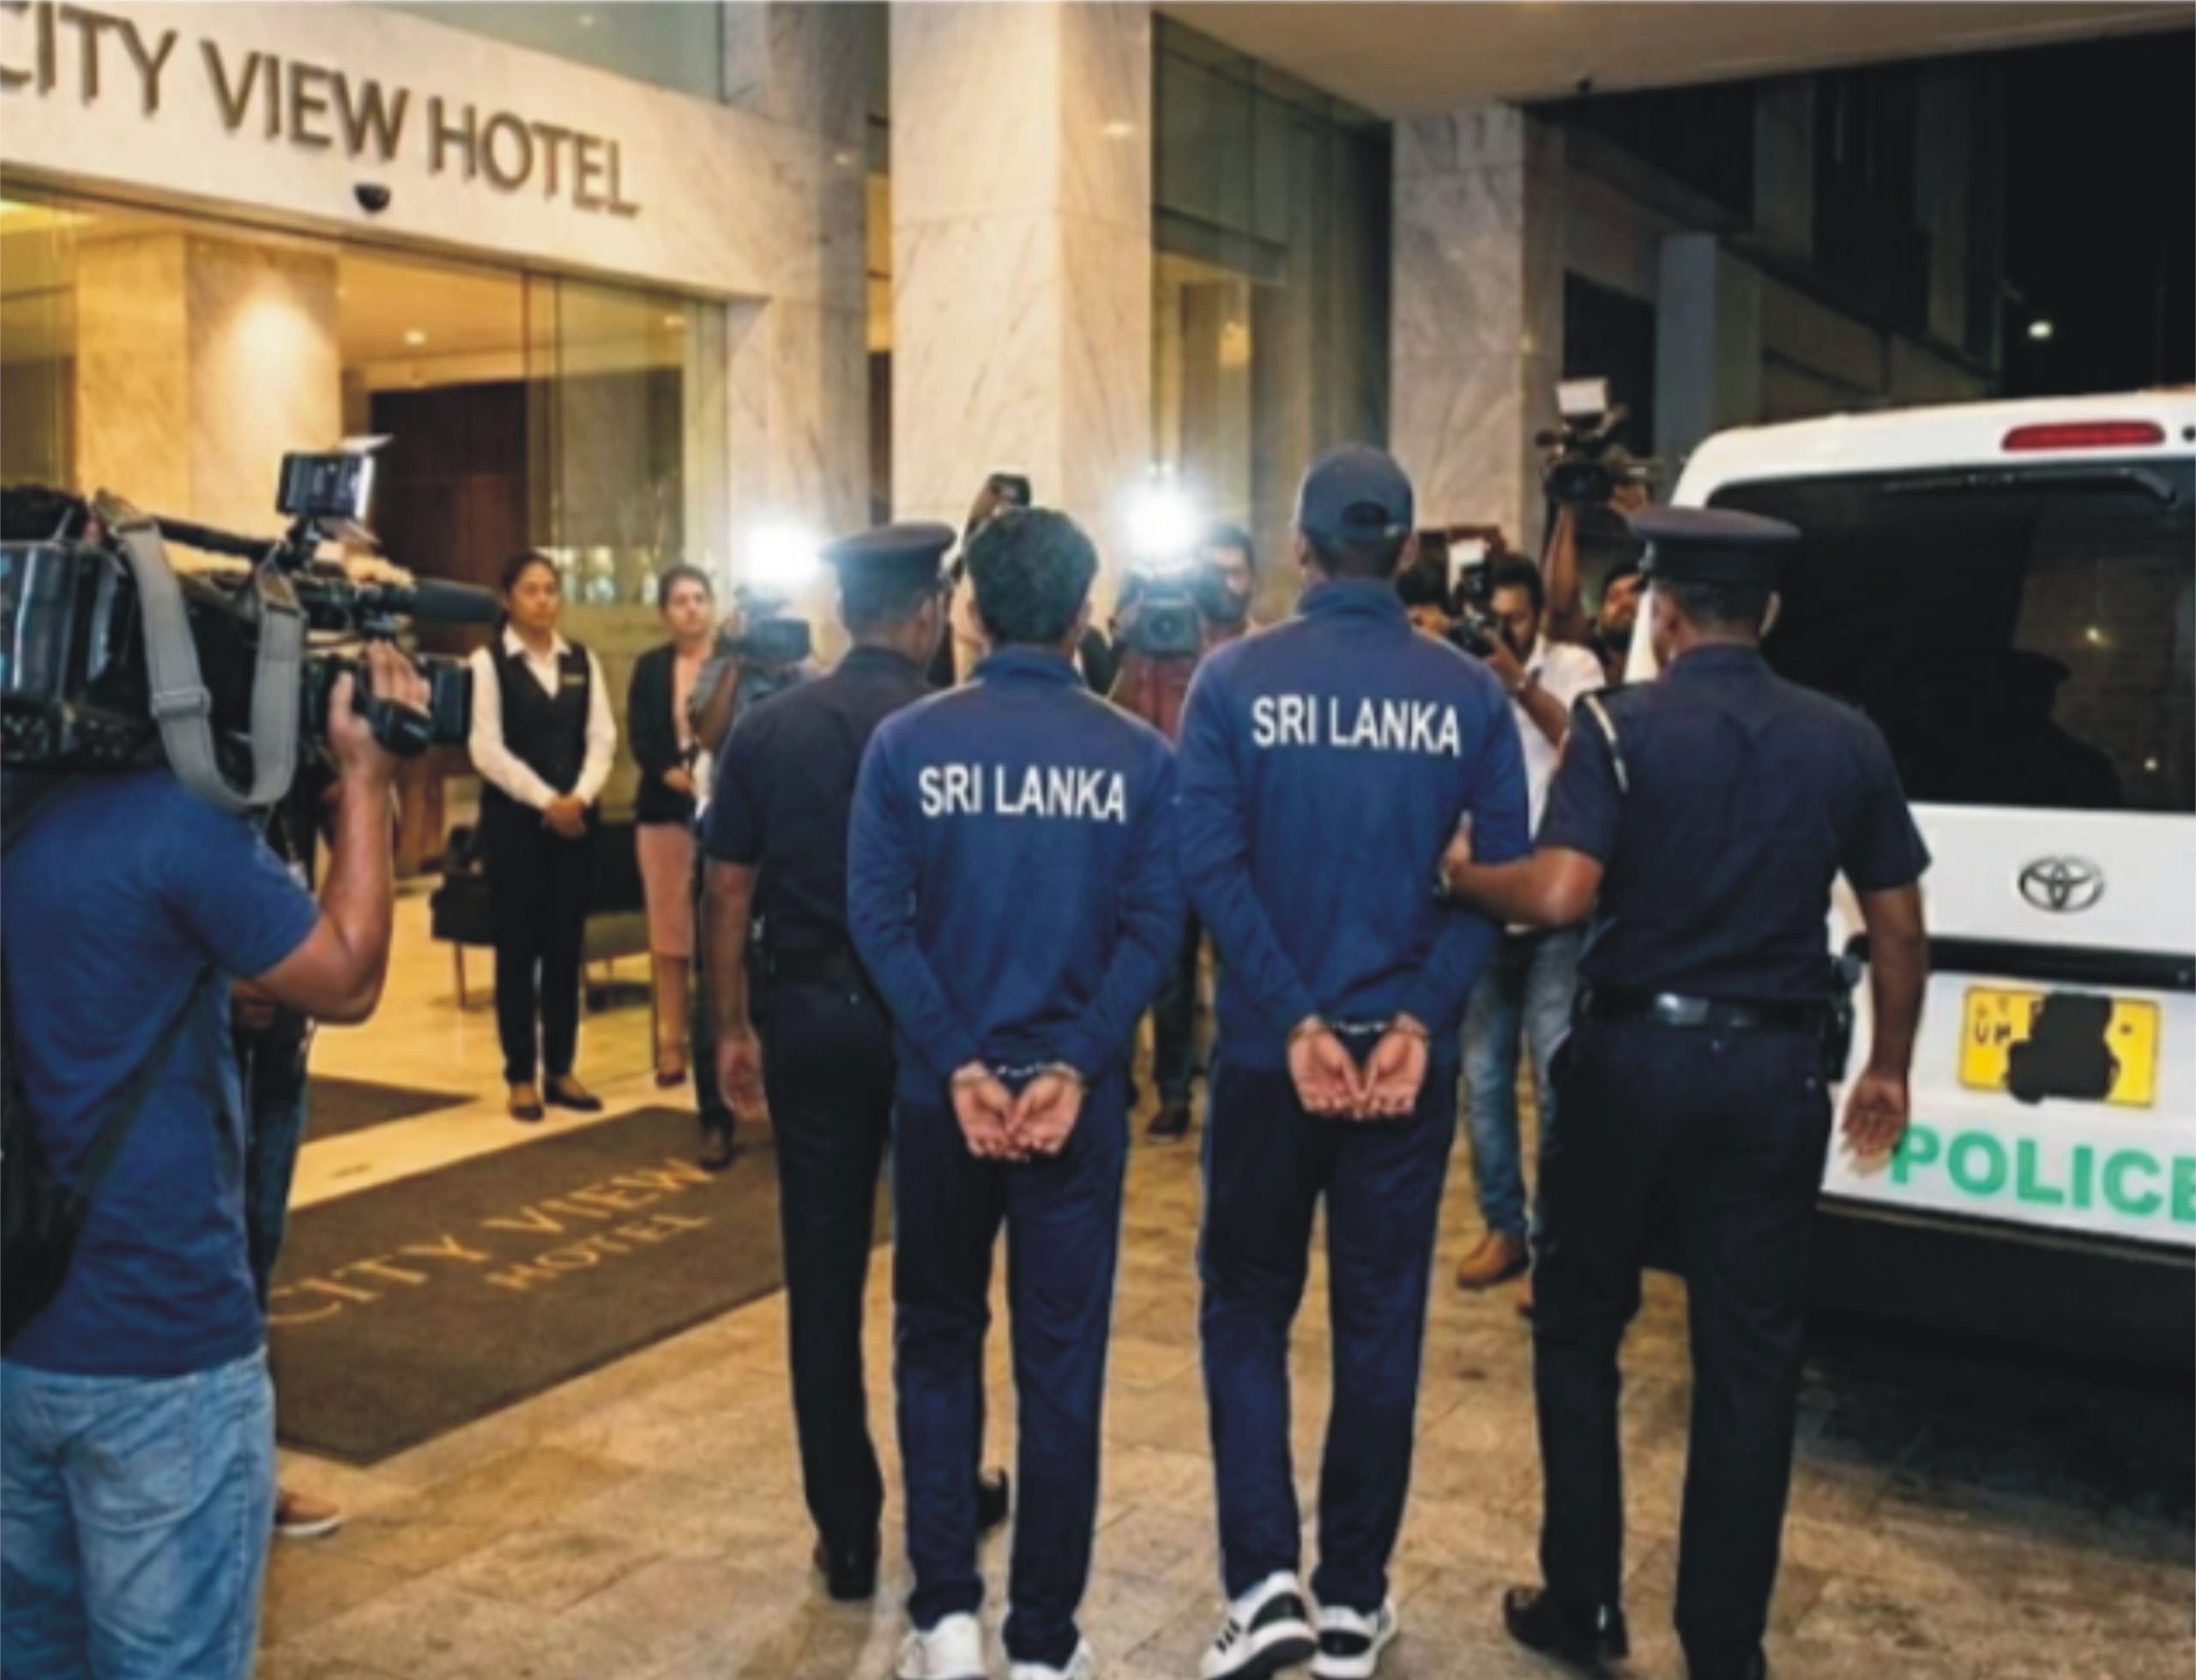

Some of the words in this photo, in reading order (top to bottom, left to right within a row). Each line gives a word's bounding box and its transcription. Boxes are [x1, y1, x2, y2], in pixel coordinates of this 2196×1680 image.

[199, 38, 410, 162] VIEW
[429, 96, 641, 218] HOTEL
[1252, 695, 1316, 745] SRI
[1329, 697, 1461, 756] LANKA
[919, 765, 983, 816] SRI
[994, 765, 1127, 822] LANKA
[1891, 1123, 2196, 1222] POLICE
[268, 1233, 492, 1323] CITY
[480, 1156, 715, 1231] VIEW
[485, 1213, 712, 1289] HOTEL
